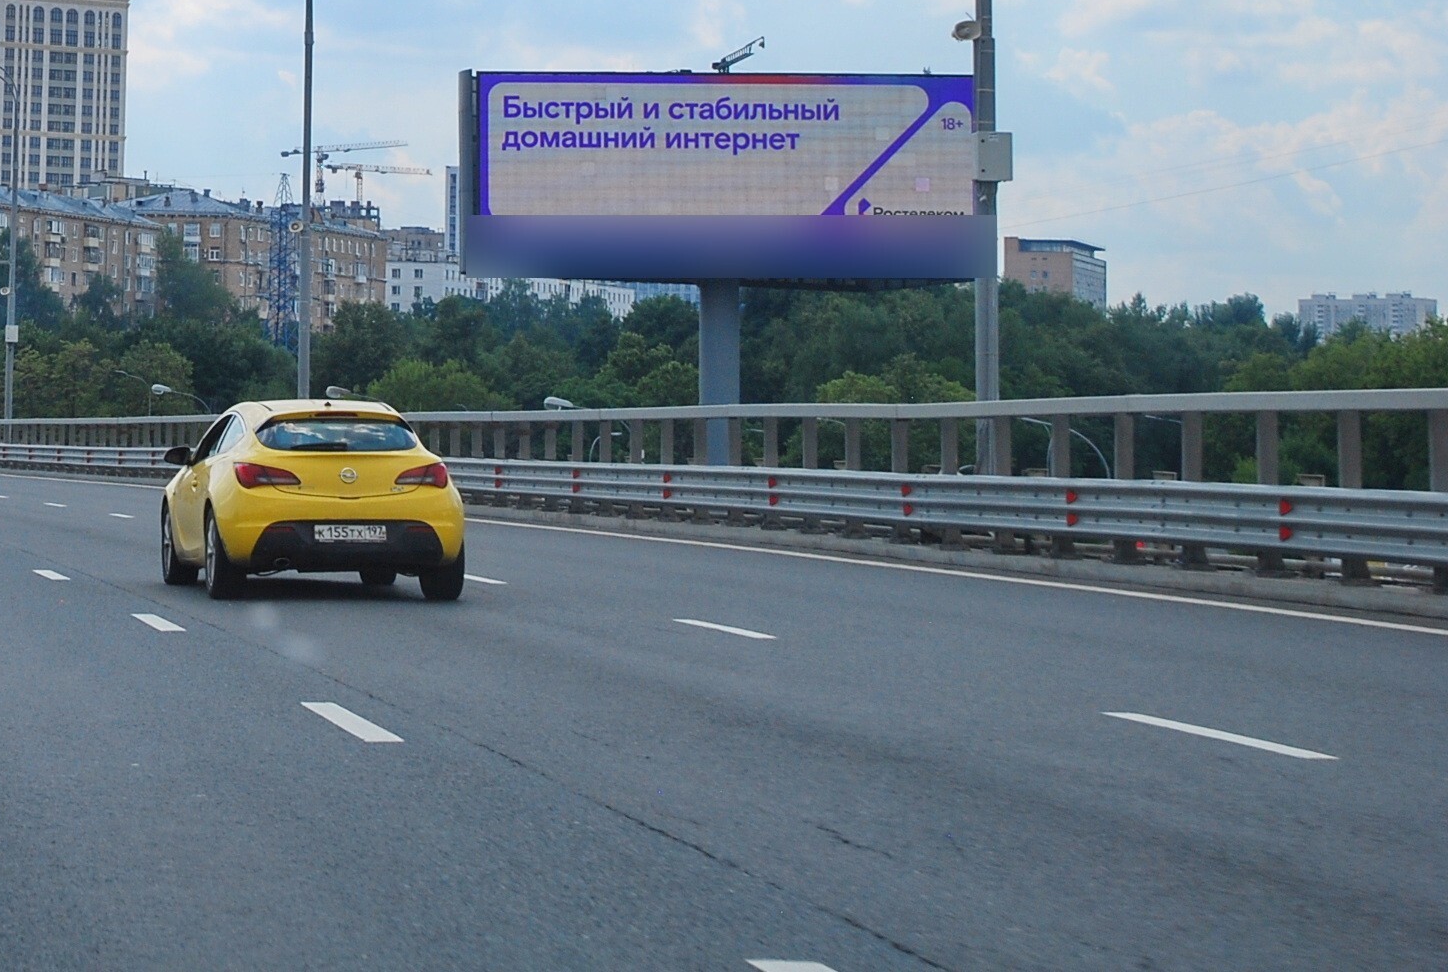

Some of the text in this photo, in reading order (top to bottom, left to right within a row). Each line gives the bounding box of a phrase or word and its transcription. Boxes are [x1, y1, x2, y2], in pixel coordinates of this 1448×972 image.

[503, 95, 840, 125] Быстрый и стабильный
[940, 117, 964, 131] 18+
[501, 126, 800, 155] домашний интернет
